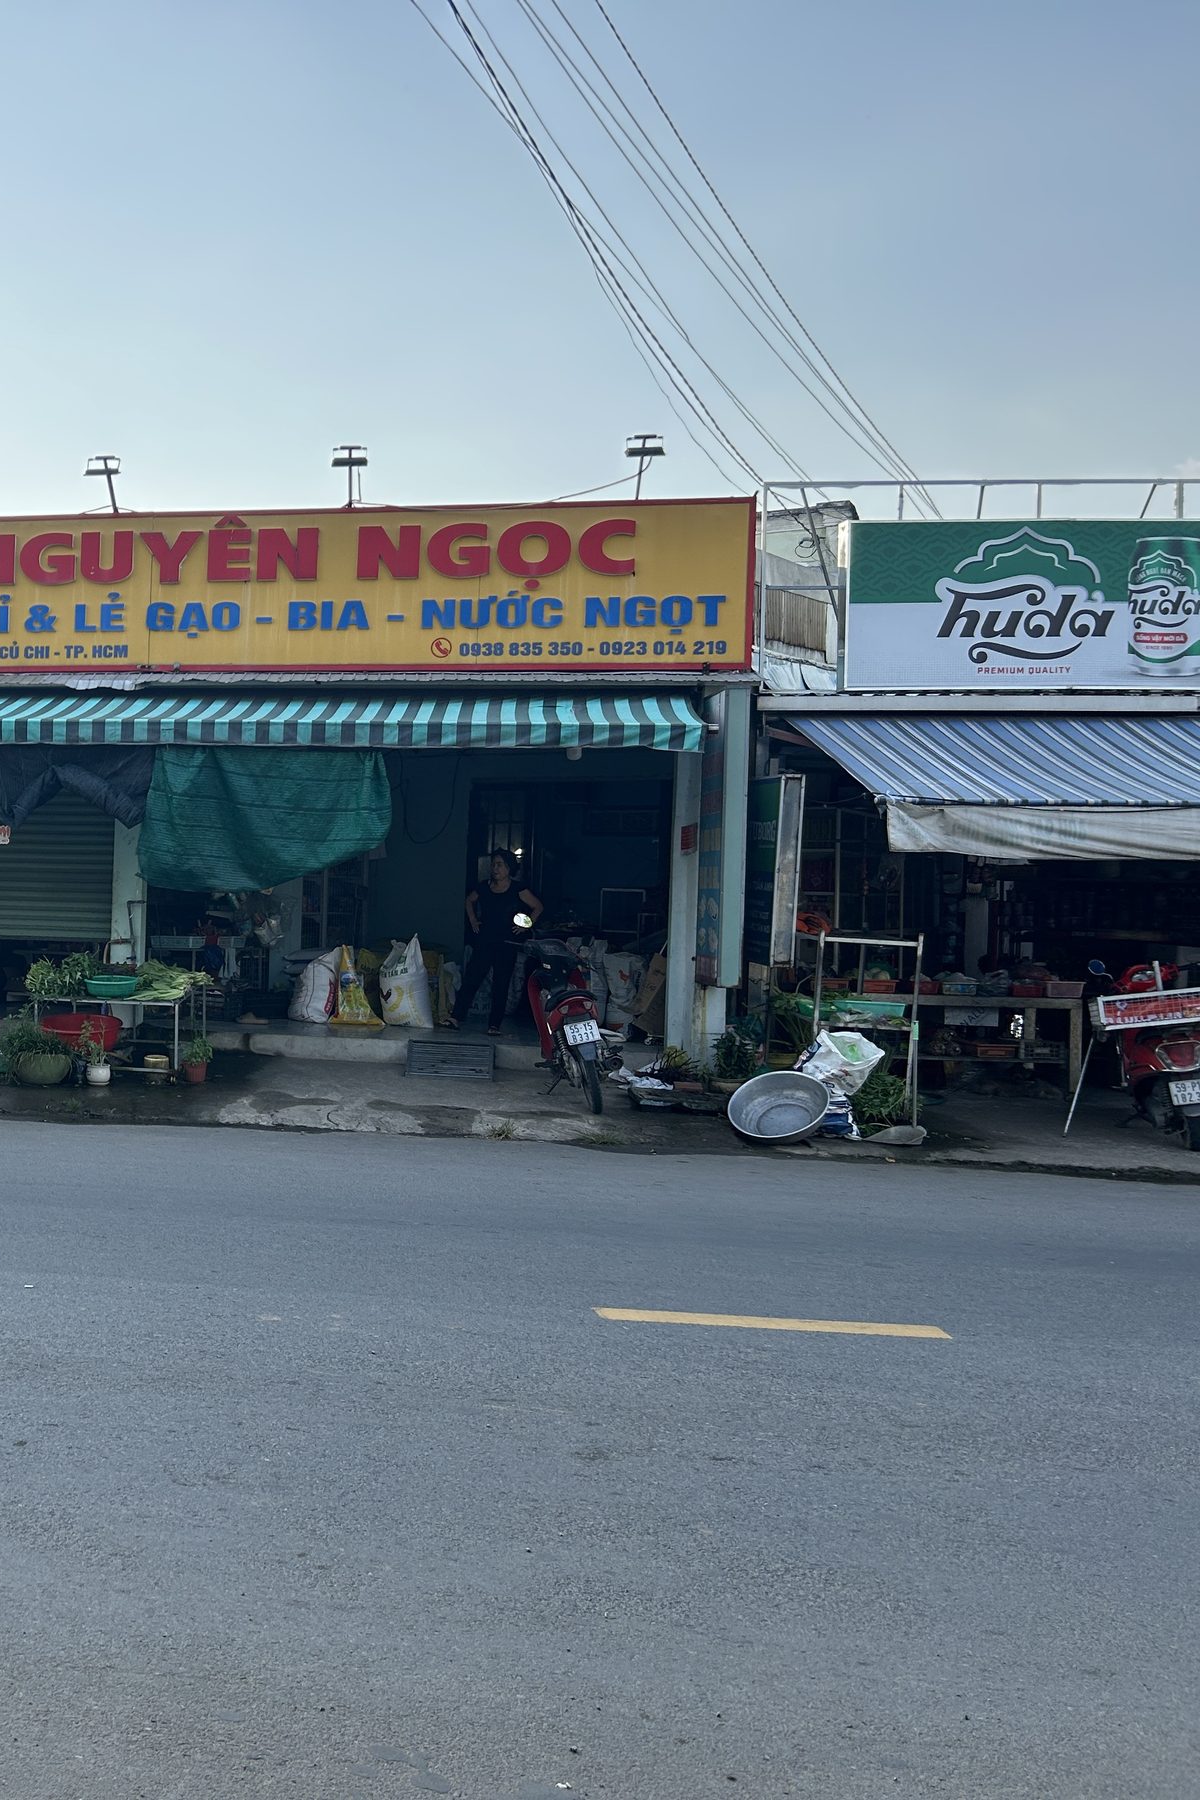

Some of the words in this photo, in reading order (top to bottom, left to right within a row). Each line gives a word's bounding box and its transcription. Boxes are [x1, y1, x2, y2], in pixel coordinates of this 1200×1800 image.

[357, 519, 636, 590] NGỌC
[24, 603, 57, 633] &
[74, 591, 126, 633] LẺ
[145, 600, 241, 639] GẠO
[287, 599, 370, 631] BIA
[420, 589, 564, 629] NƯỚC
[584, 594, 727, 635] NGỌT
[937, 583, 1115, 638] huda
[23, 646, 50, 659] CHI
[64, 645, 88, 659] TP.
[92, 645, 129, 658] HCM
[459, 642, 504, 656] 0938
[508, 642, 543, 656] 835
[548, 642, 583, 656] 350
[599, 641, 647, 656] 0923
[653, 641, 686, 655] 014
[693, 640, 727, 655] 219
[977, 666, 1025, 675] PREMIUM
[1028, 666, 1071, 676] QUALITY
